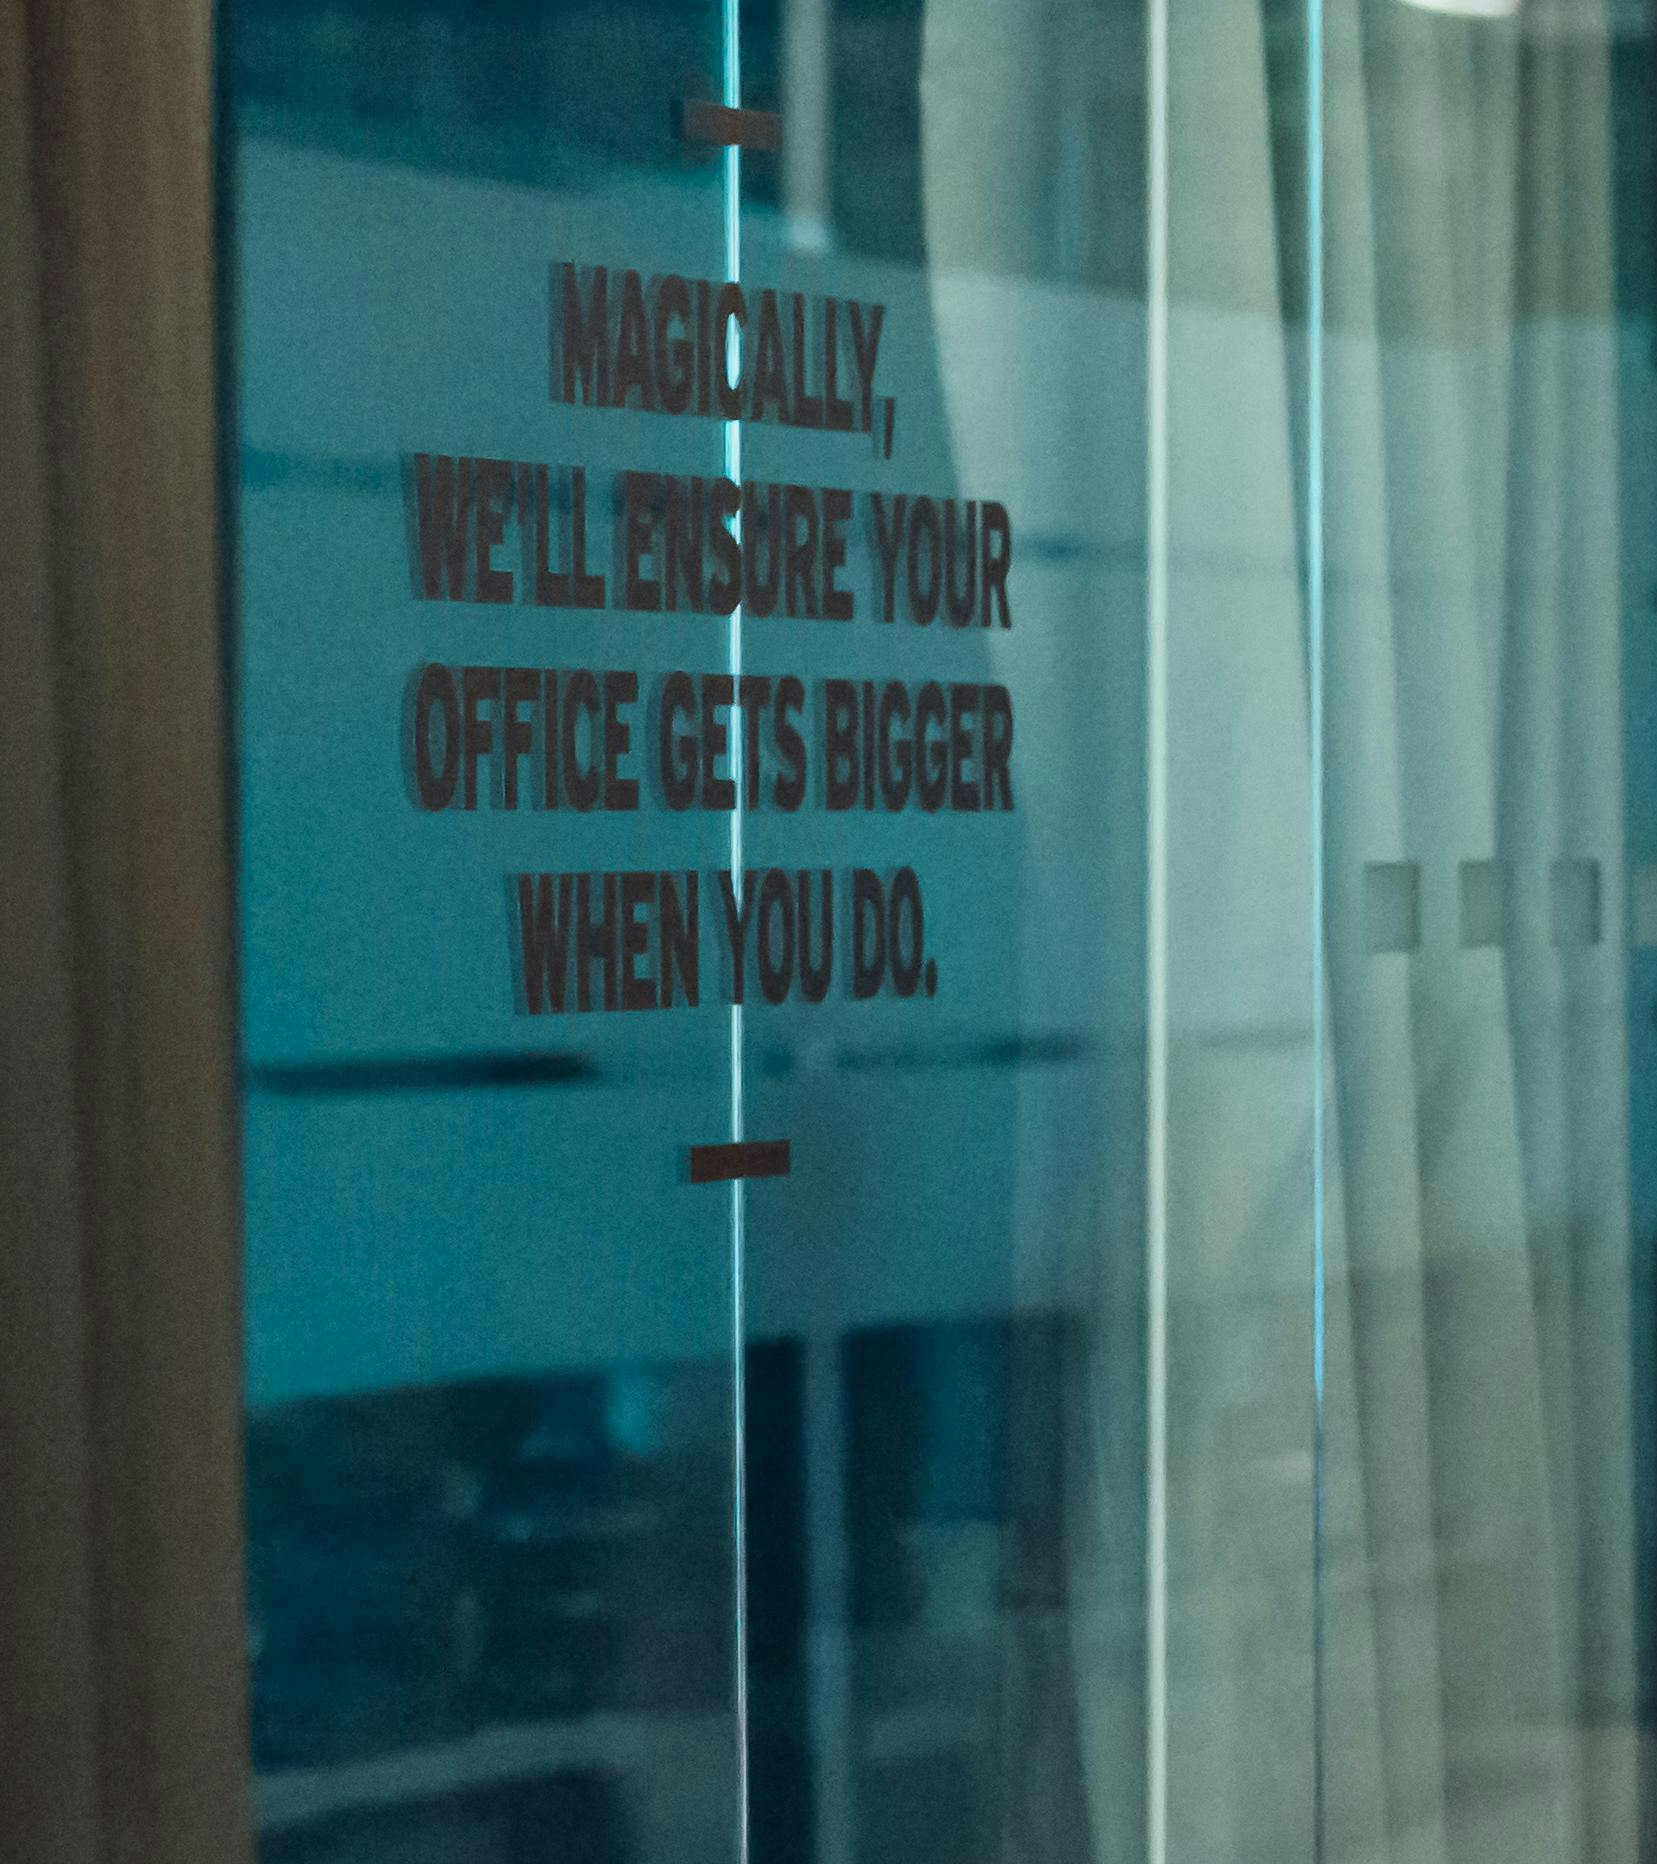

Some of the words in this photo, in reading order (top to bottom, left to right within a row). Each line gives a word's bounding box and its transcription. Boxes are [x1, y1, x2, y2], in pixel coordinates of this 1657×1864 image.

[560, 261, 896, 460] MAGICALLY,
[413, 452, 606, 610] WE'LL
[625, 470, 854, 622] ENSURE
[870, 492, 1012, 630] YOUR
[414, 661, 641, 813] OFFICE
[660, 670, 807, 813] GETS
[825, 678, 1015, 814] BIGGER
[517, 869, 700, 1017] WHEN
[719, 867, 833, 1006] YOU
[853, 865, 938, 1001] DO.
